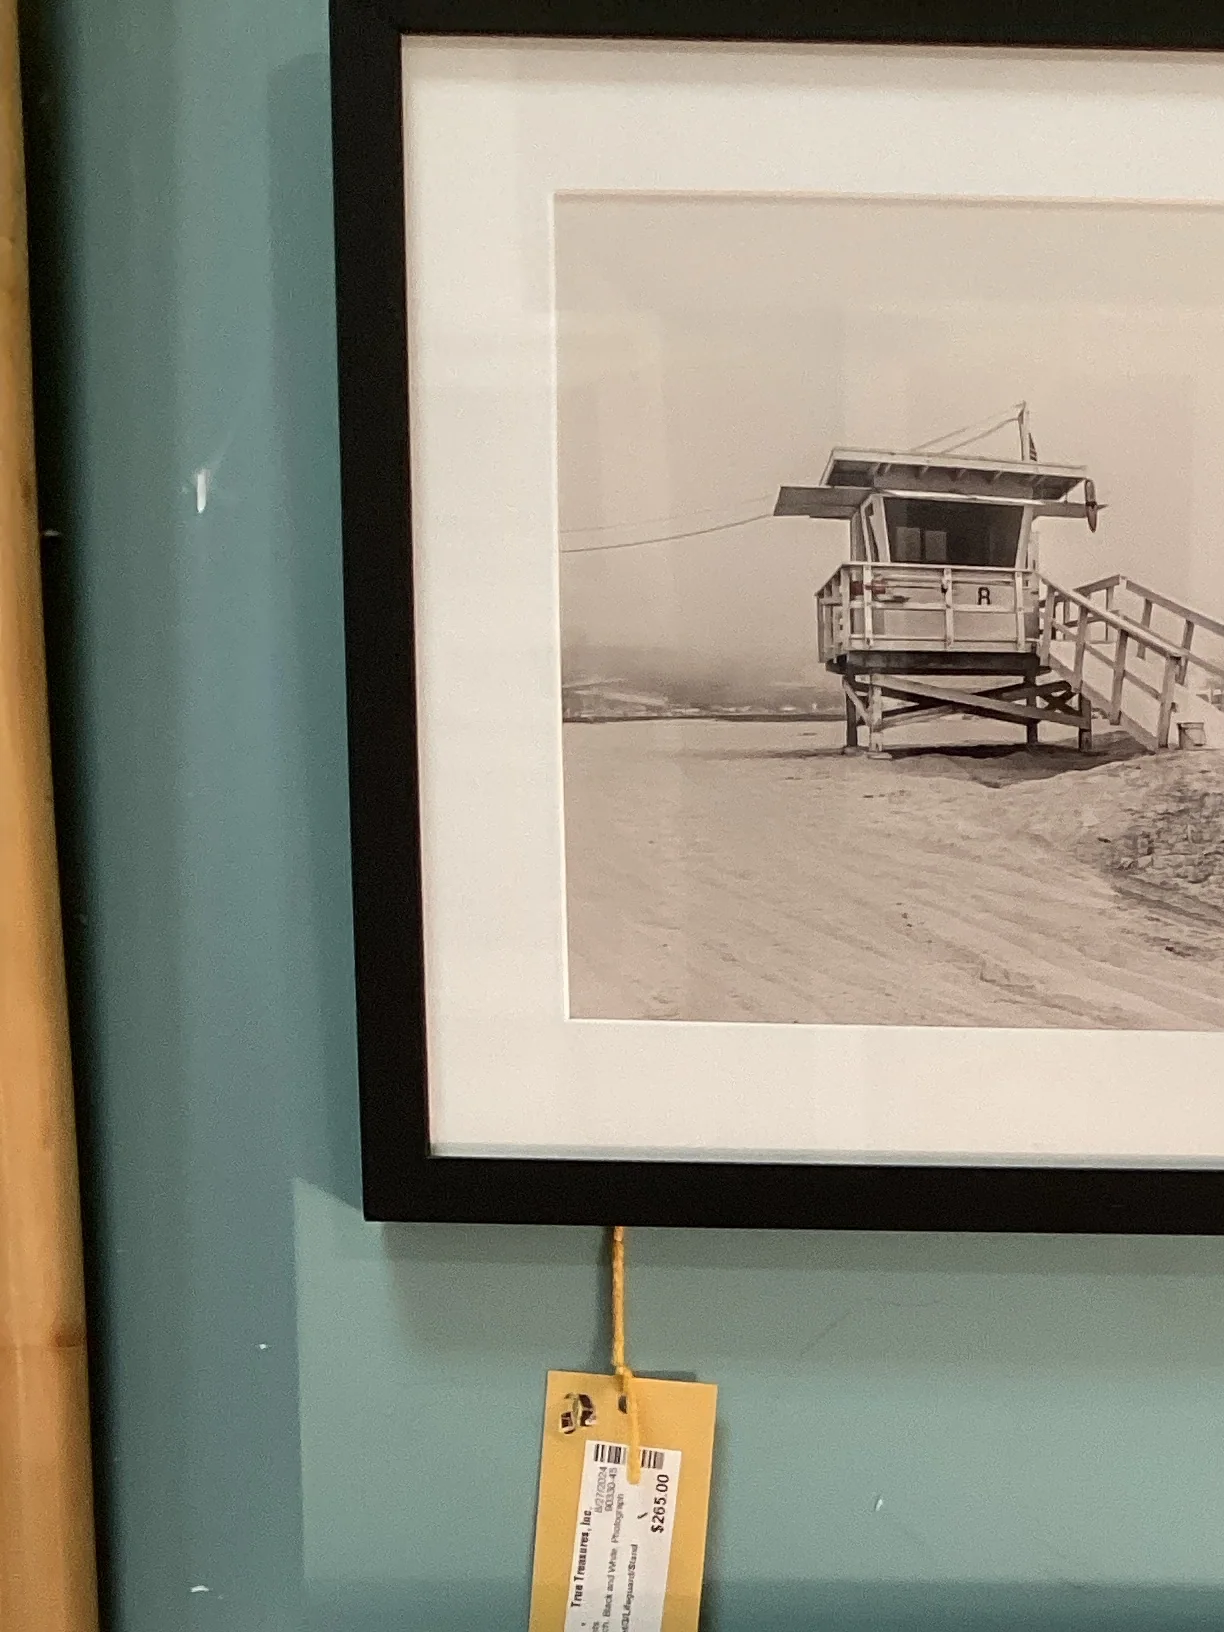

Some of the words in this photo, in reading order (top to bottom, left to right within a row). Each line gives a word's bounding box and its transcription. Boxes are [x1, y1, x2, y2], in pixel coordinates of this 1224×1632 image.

[650, 1473, 670, 1534] $265.00
[574, 1526, 593, 1582] Treasures,
[602, 1593, 612, 1617] Black
[607, 1574, 615, 1592] and
[611, 1493, 625, 1543] Photograph
[571, 1584, 583, 1608] True
